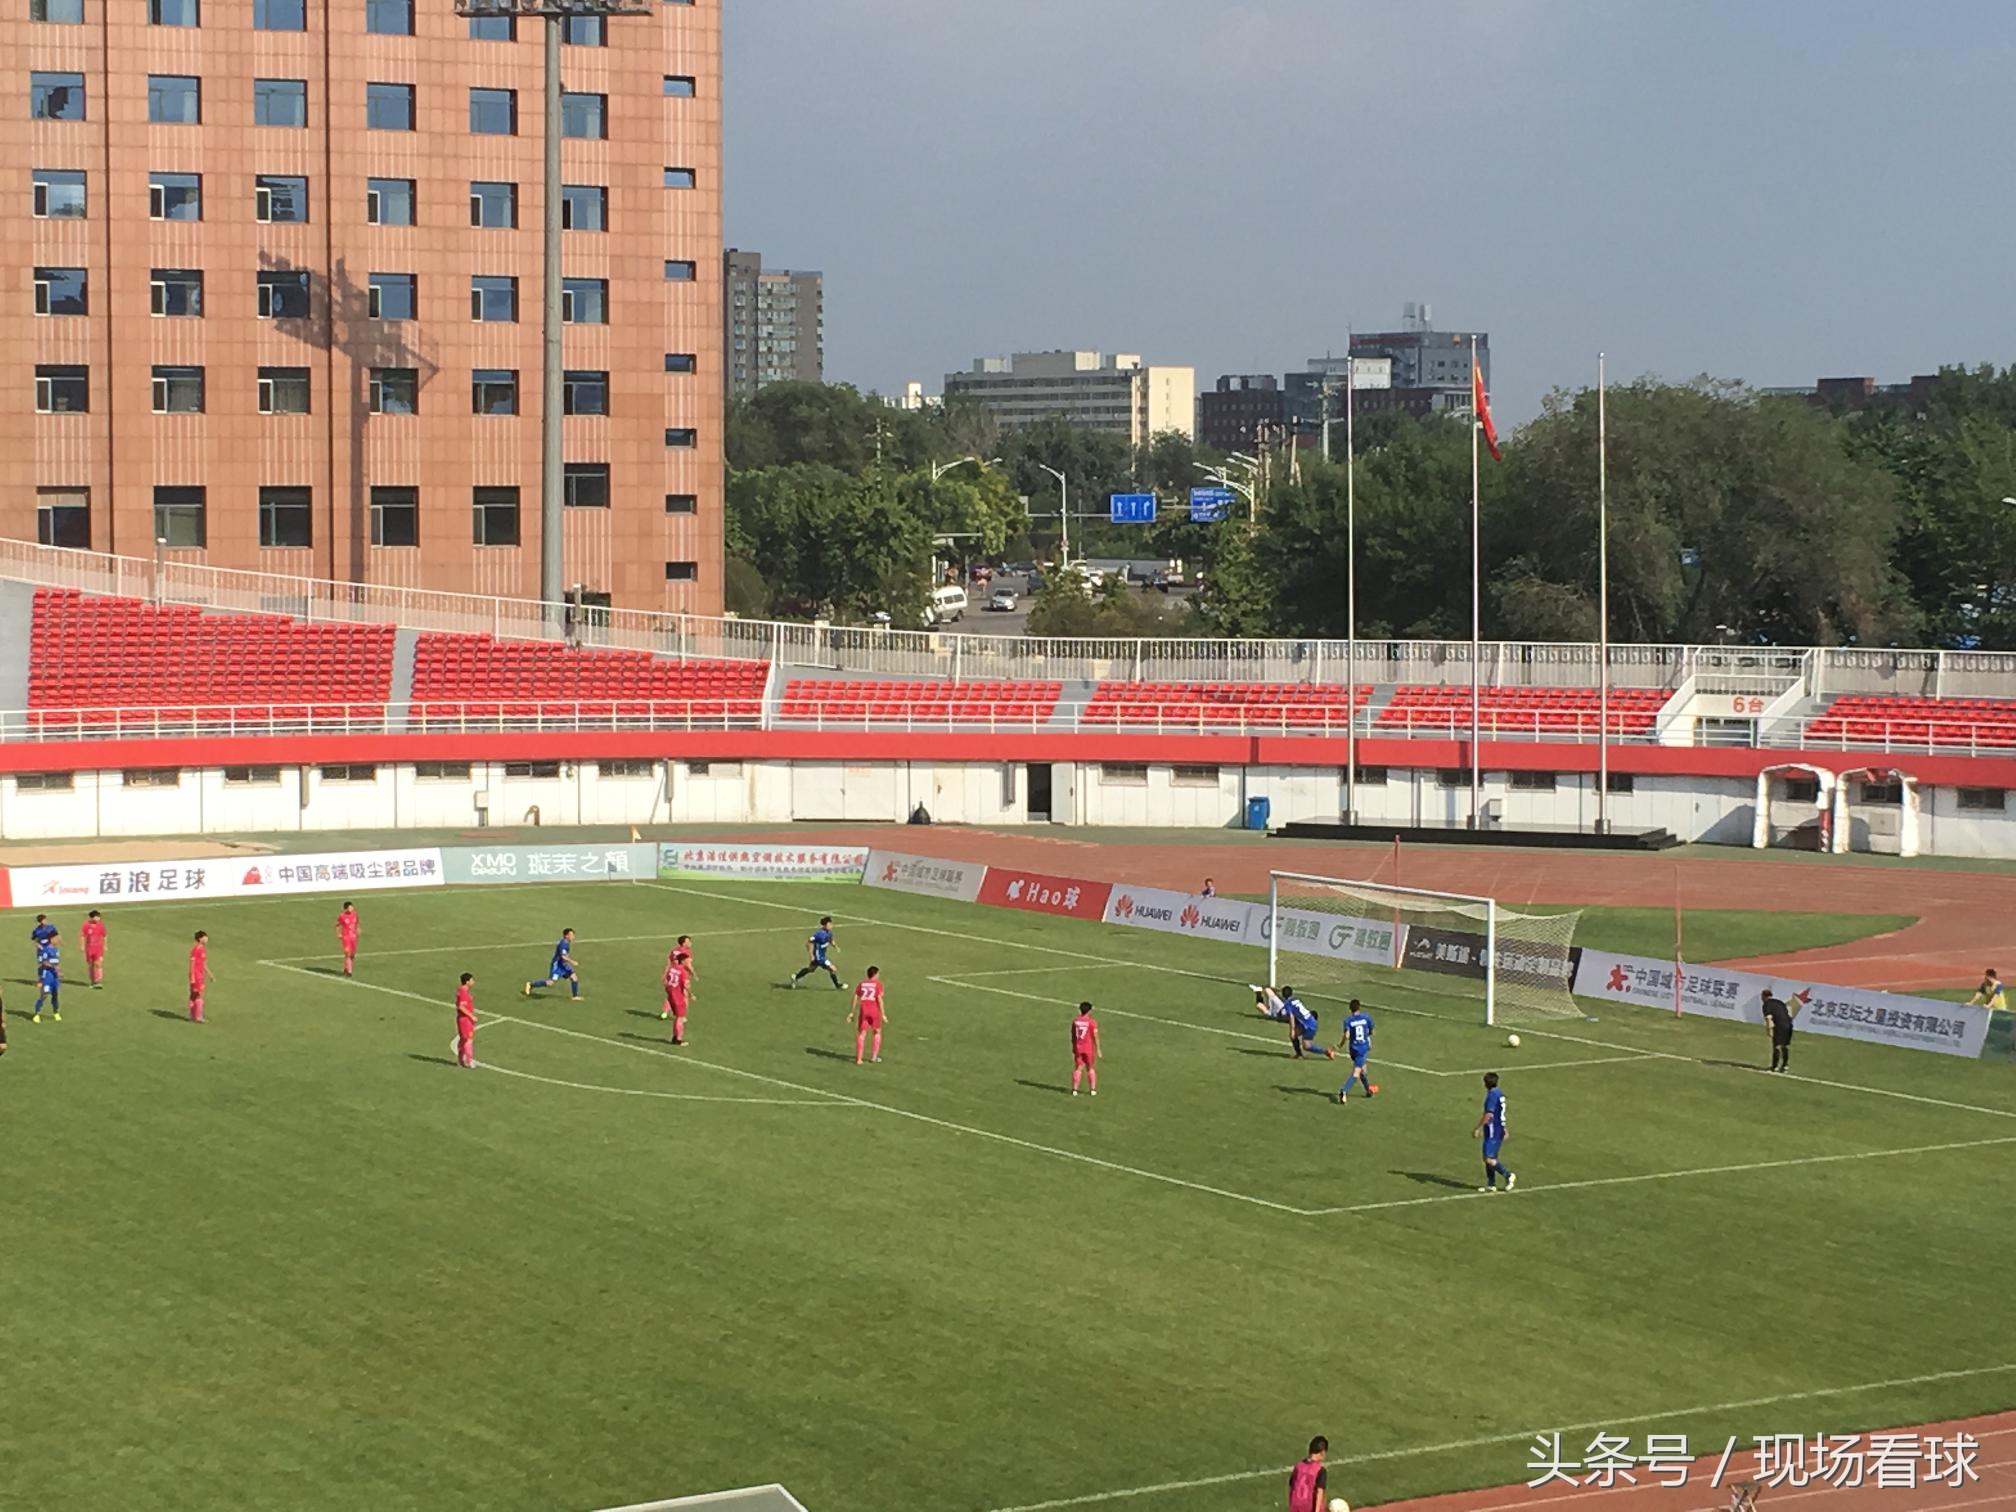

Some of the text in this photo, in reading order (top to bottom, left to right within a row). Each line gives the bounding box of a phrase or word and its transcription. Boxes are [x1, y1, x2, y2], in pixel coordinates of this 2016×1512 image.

[1733, 696, 1765, 713] 6台
[99, 868, 206, 894] 茵浪足球
[279, 859, 436, 883] 中国高端吸尘器品牌
[1134, 905, 1240, 932] HUAWEI HUAWEI
[861, 987, 876, 1001] 22
